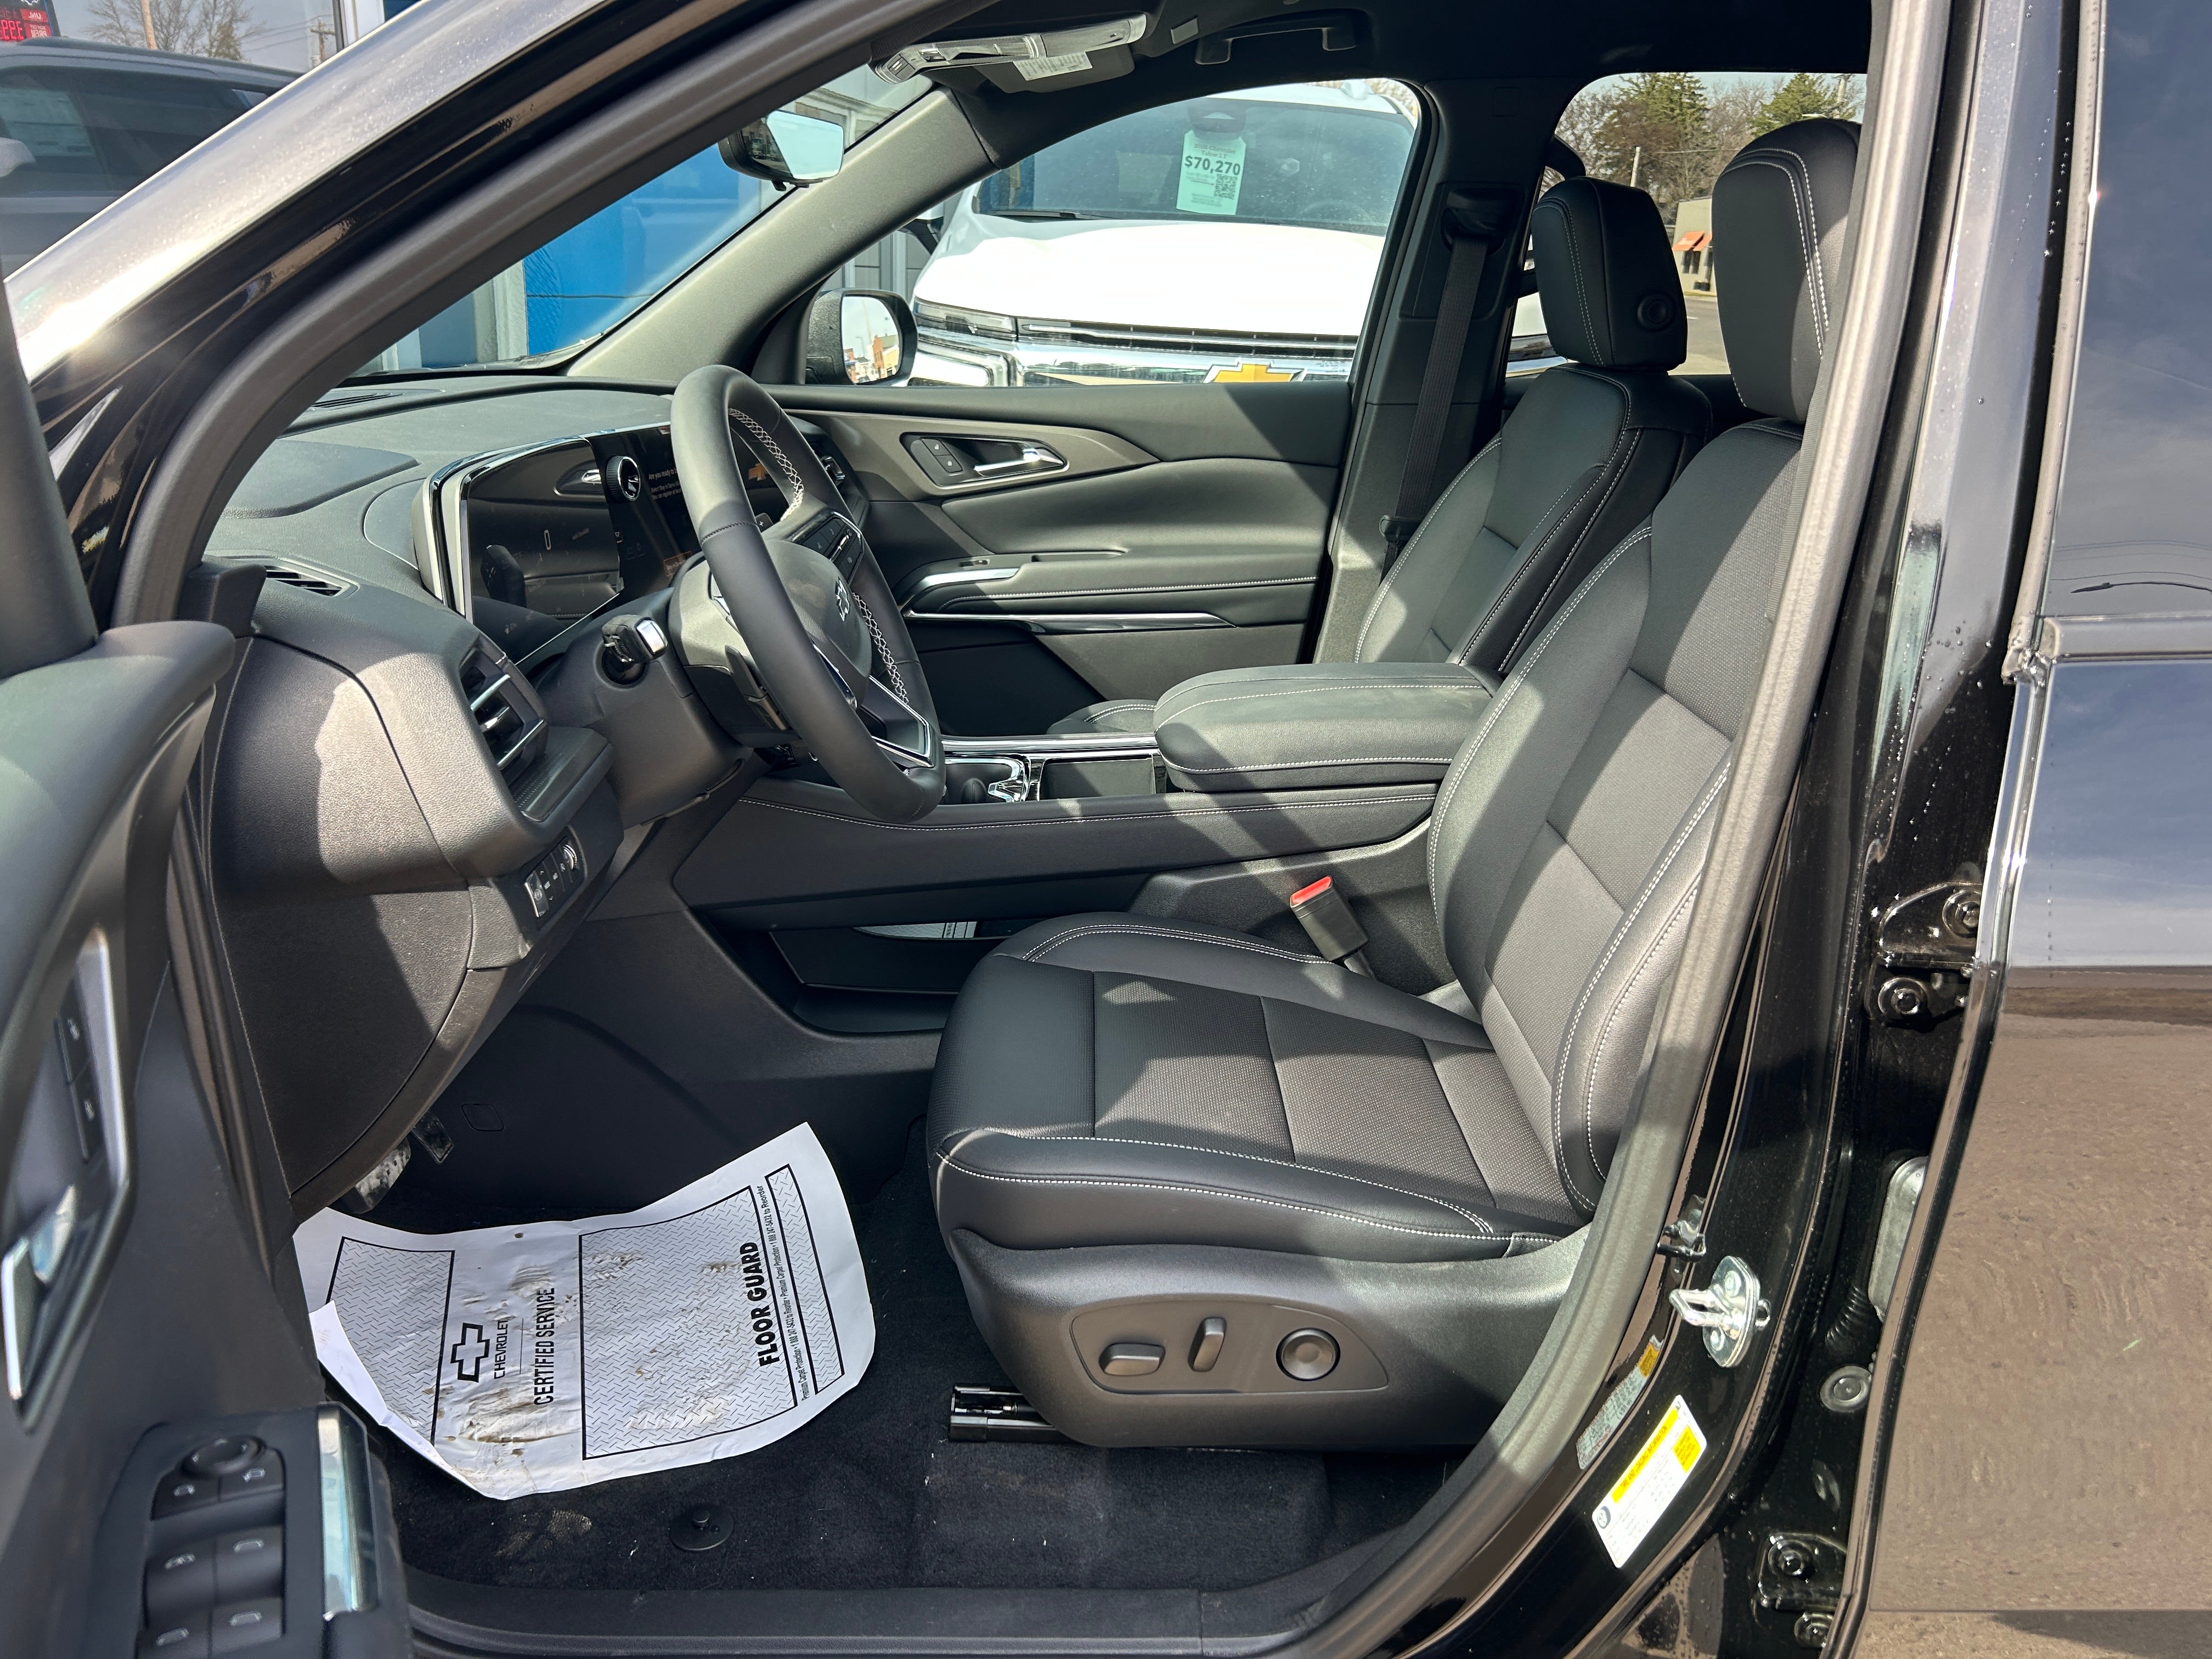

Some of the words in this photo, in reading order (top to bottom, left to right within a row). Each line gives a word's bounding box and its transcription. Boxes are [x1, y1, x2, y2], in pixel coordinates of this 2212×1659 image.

[1184, 155, 1240, 176] $70,270
[757, 1186, 769, 1209] Reorder
[764, 1214, 775, 1234] 247-5432
[768, 1234, 777, 1242] 888
[771, 1246, 782, 1266] Protection
[740, 1242, 768, 1302] GUARD
[776, 1266, 786, 1279] Carpet
[780, 1279, 788, 1297] Premium
[535, 1288, 555, 1338] SERVICE
[783, 1299, 792, 1314] Reorder
[751, 1305, 780, 1367] FLOOR
[786, 1317, 797, 1336] 247-5432
[494, 1320, 509, 1379] CHEVROLET
[789, 1335, 799, 1344] 888
[794, 1348, 804, 1370] Protection
[534, 1340, 555, 1406] CERTIFIED
[798, 1368, 808, 1383] Carpet
[1620, 1477, 1629, 1489] TIRE
[1627, 1469, 1635, 1481] AND
[1635, 1451, 1649, 1472] LOADING
[1647, 1425, 1667, 1454] INFORMATION
